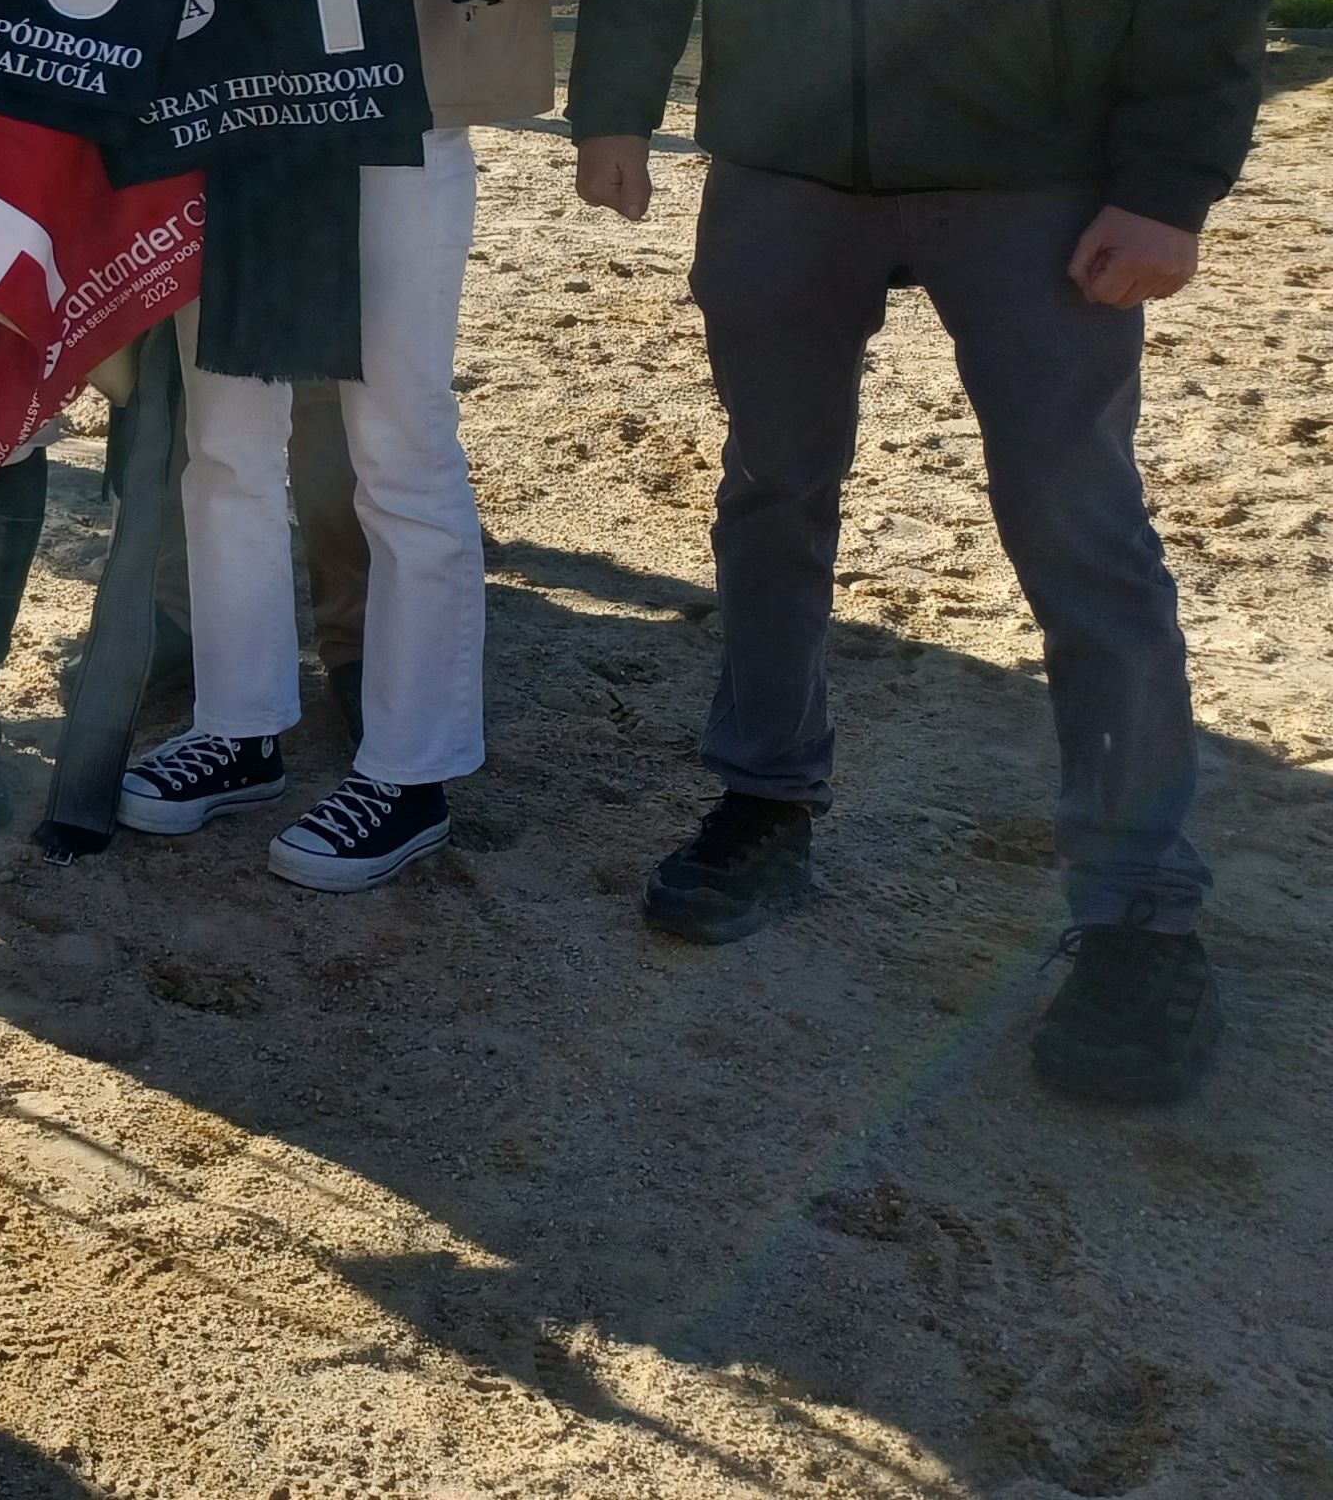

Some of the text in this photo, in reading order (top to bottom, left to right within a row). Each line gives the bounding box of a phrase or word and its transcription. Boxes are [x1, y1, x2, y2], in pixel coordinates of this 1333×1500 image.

[224, 63, 405, 101] HIPÓDROMO
[169, 92, 384, 149] DE ANDALUCÍA
[65, 240, 200, 349] SAN SEBASTIAN MADRID DOS
[140, 276, 180, 310] 2023
